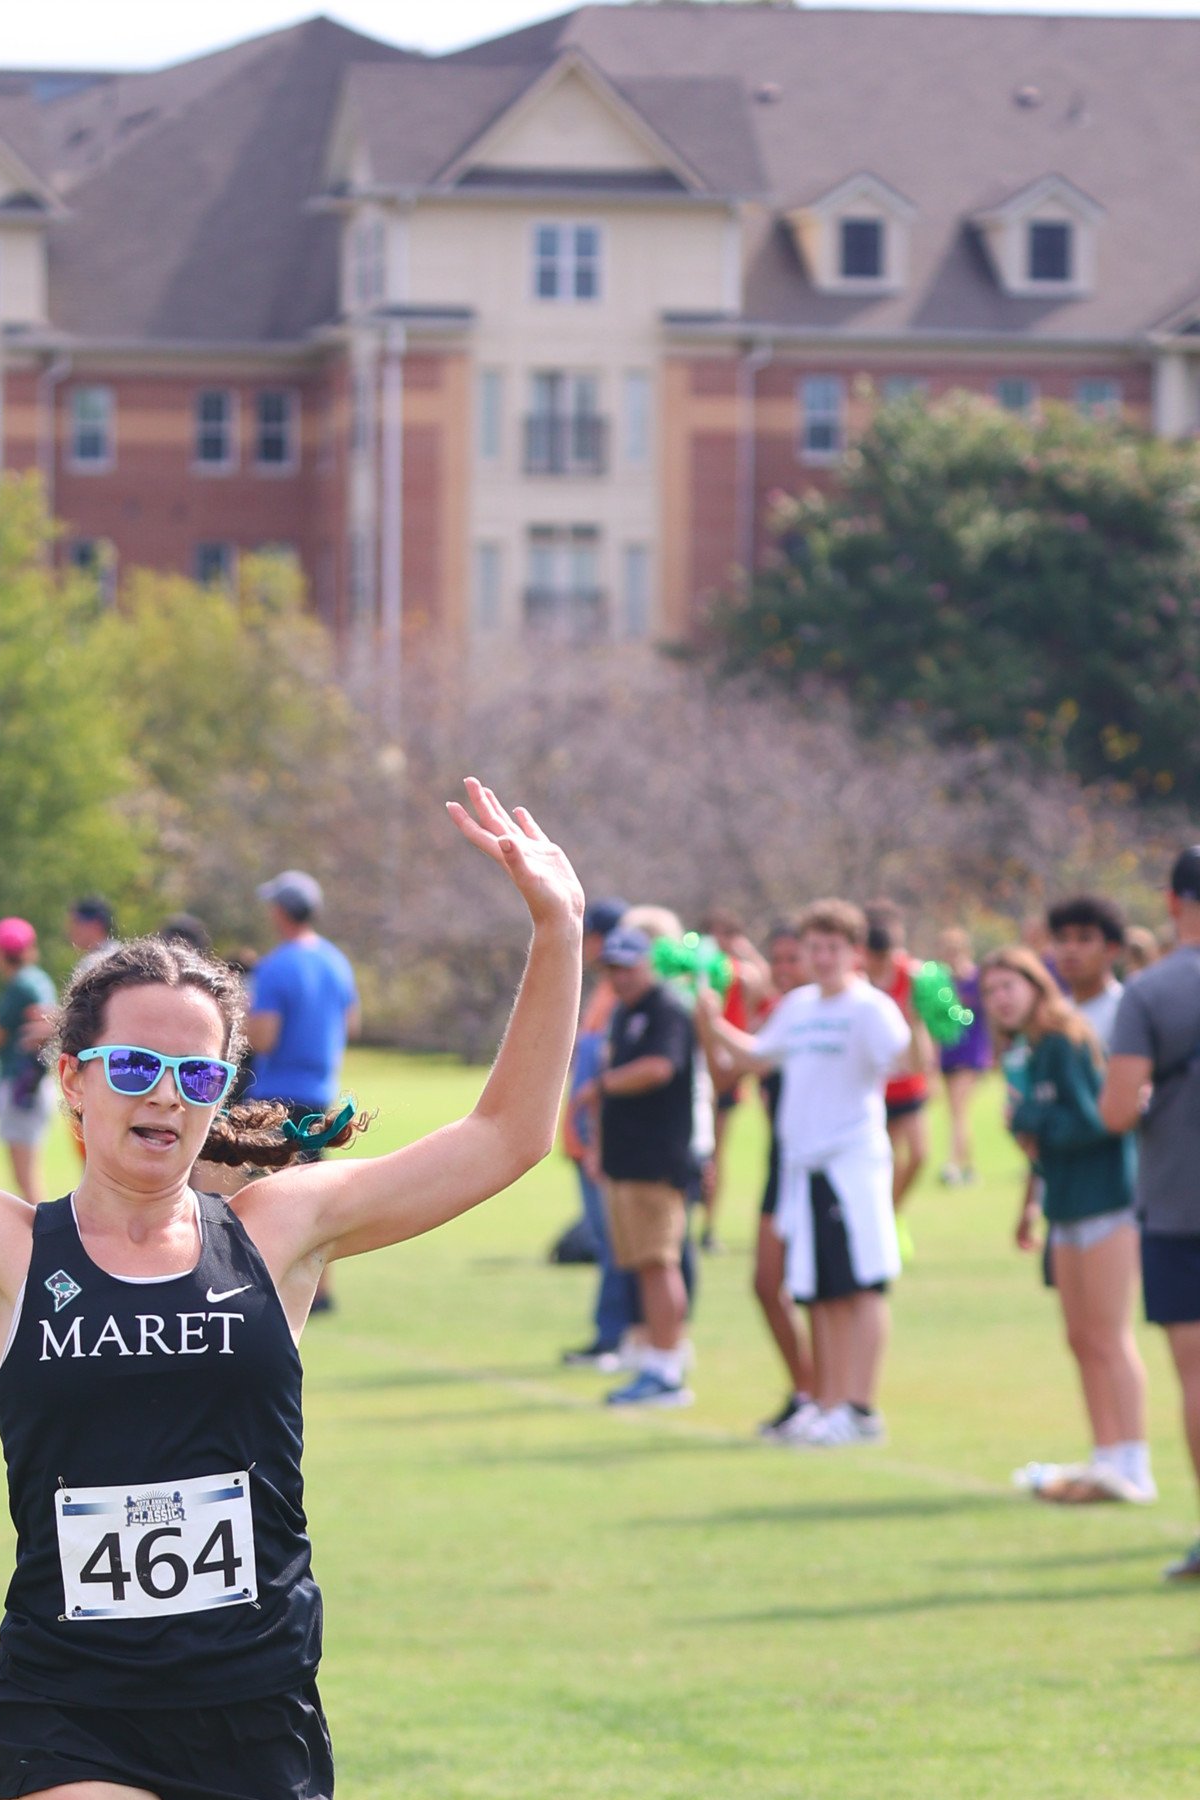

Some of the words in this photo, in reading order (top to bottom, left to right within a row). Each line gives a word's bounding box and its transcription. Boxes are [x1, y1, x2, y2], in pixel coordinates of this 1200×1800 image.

[39, 1312, 245, 1361] MARET
[132, 1508, 181, 1522] CLASSIC
[79, 1519, 242, 1601] 464
